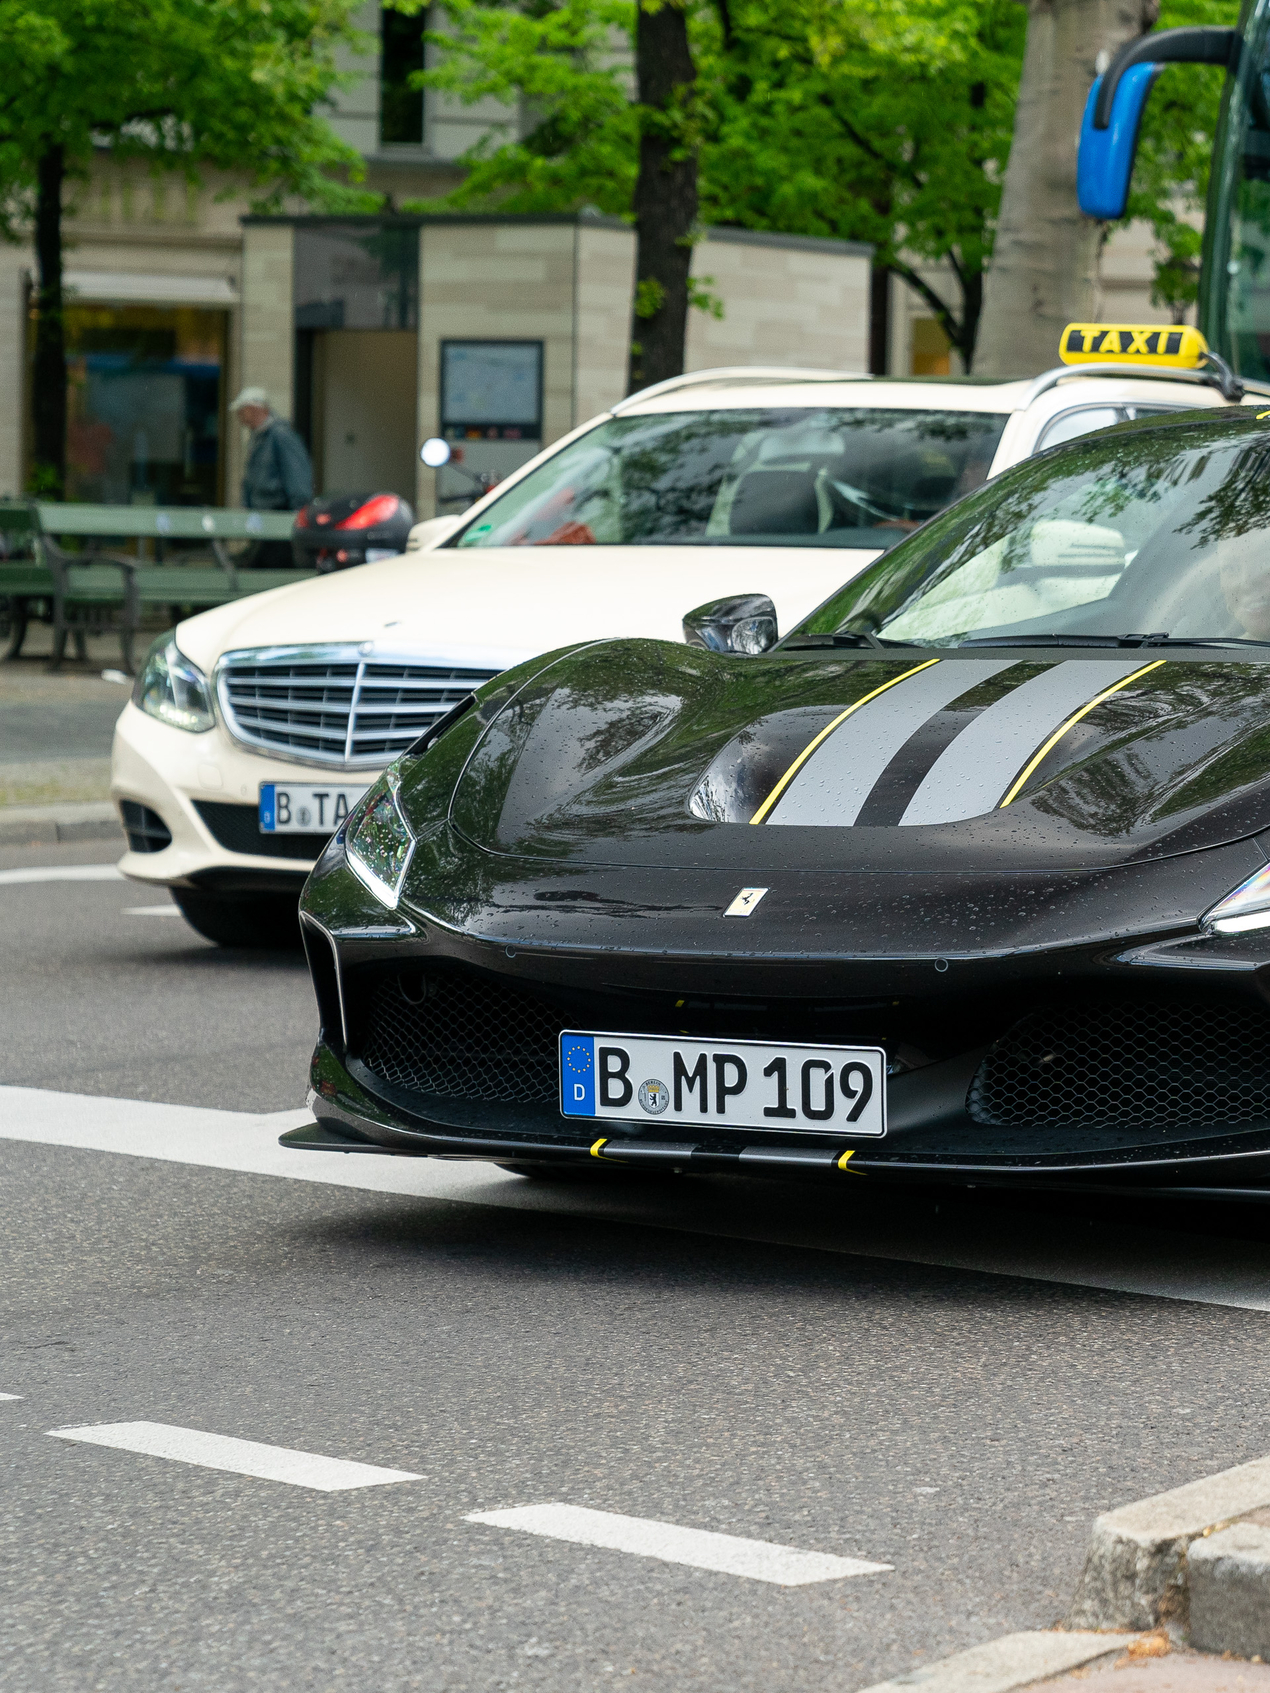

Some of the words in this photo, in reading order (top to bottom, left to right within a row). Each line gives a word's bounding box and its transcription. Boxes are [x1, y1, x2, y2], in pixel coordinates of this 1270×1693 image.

[1080, 330, 1169, 354] TAXI
[277, 792, 291, 824] B
[573, 1083, 586, 1101] D
[599, 1046, 634, 1108] B
[672, 1051, 748, 1115] MP
[763, 1056, 874, 1123] 109
